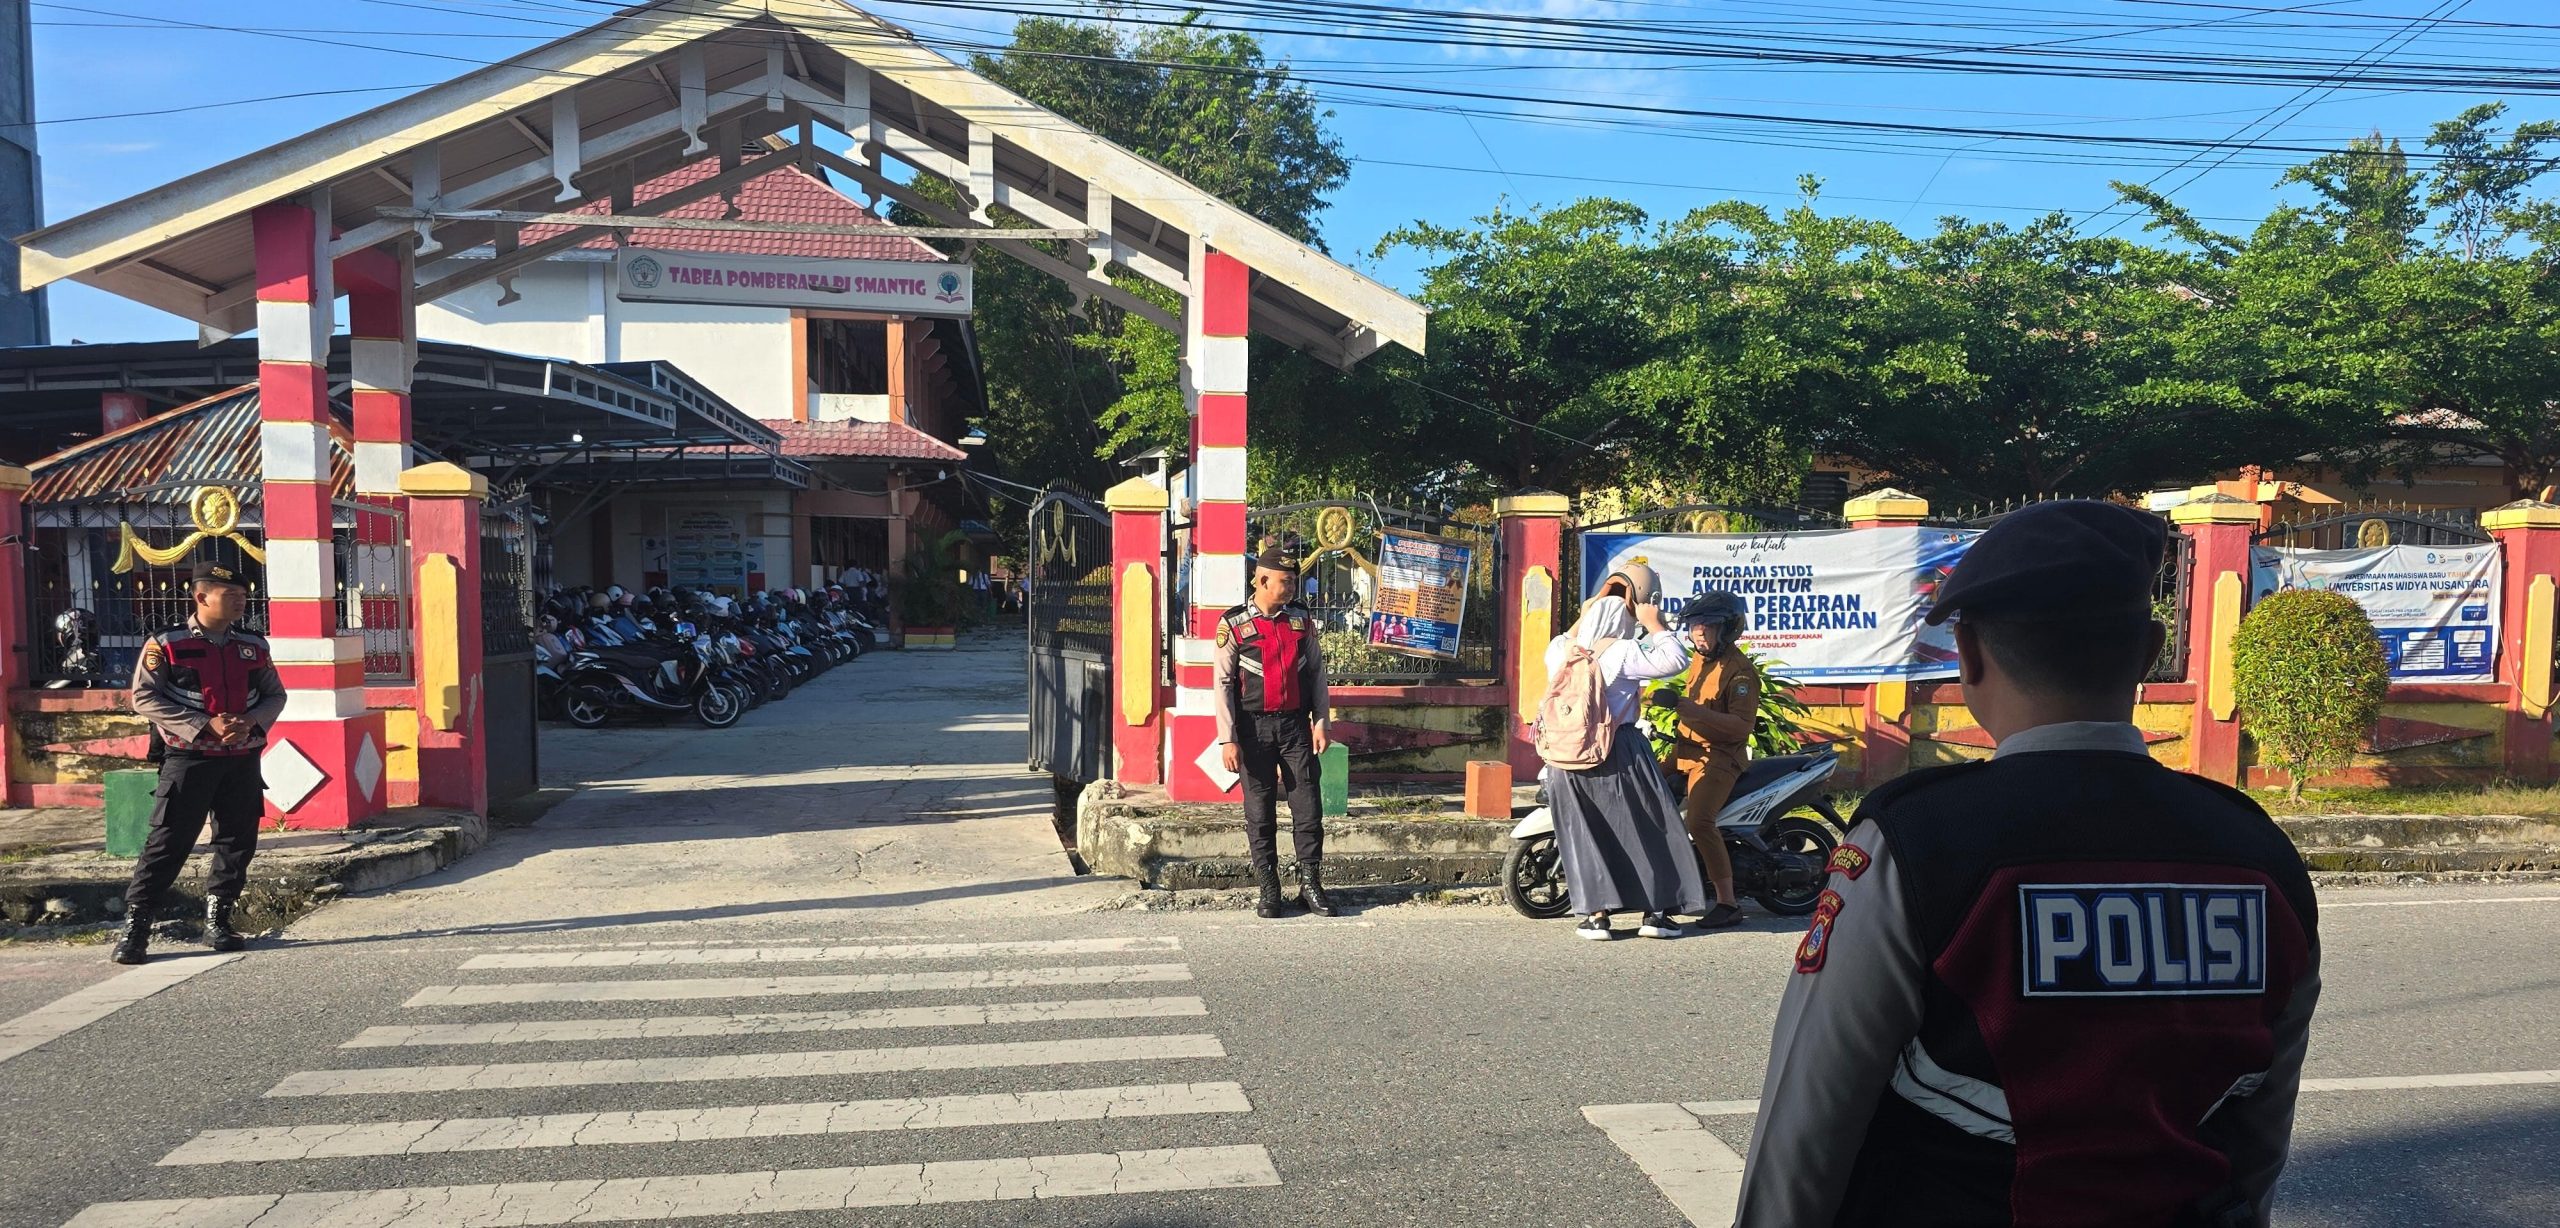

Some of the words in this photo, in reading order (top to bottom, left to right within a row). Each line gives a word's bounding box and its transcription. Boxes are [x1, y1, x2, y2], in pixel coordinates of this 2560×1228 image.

[669, 267, 723, 286] TABEA
[727, 270, 829, 290] POMBERATA
[855, 277, 926, 295] SMANTIG
[1726, 541, 1746, 557] ayo
[1751, 534, 1788, 551] kuliah
[1751, 553, 1760, 563] di
[1693, 566, 1766, 578] PROGRAM
[1770, 565, 1813, 577] STUDI
[2329, 581, 2393, 592] UNIVERSITAS
[2396, 581, 2428, 591] WIDYA
[1754, 594, 1860, 613] PERAIRAN
[1754, 612, 1877, 630] PERIKANAN
[2033, 895, 2261, 984] POLISI
